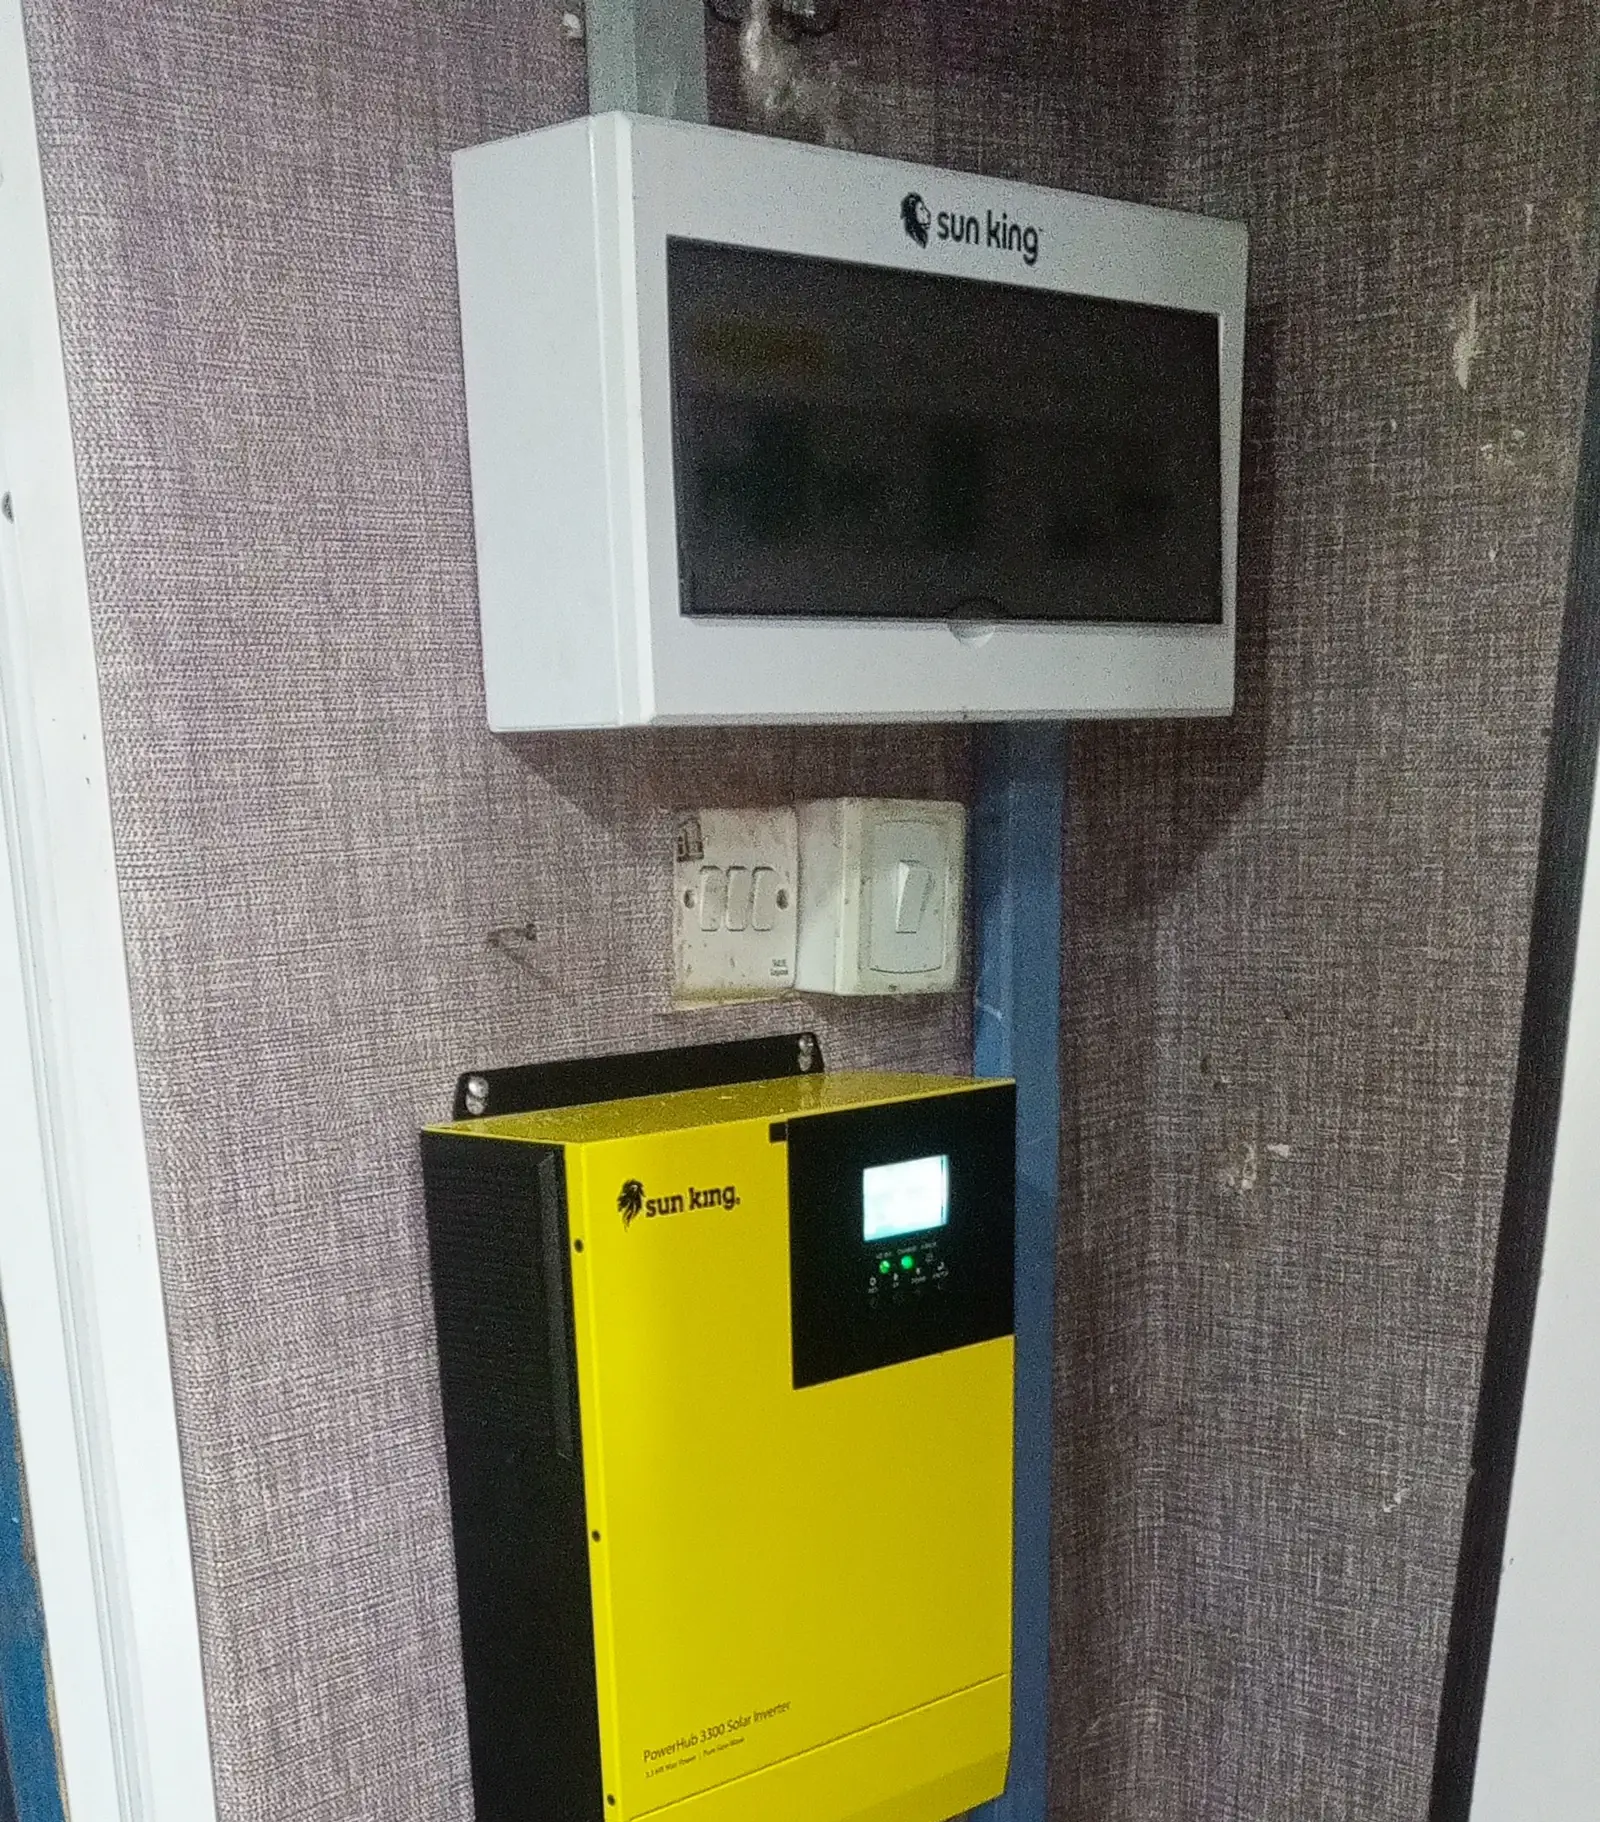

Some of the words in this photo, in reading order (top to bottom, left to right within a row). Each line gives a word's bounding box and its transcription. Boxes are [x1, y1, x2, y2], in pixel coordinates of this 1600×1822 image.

[937, 211, 979, 244] sun
[987, 209, 1039, 266] king
[645, 1194, 685, 1218] sun
[643, 1733, 698, 1763] PowerHub
[700, 1722, 725, 1743] 3300
[727, 1716, 751, 1733] Solar
[753, 1700, 792, 1723] Inverter
